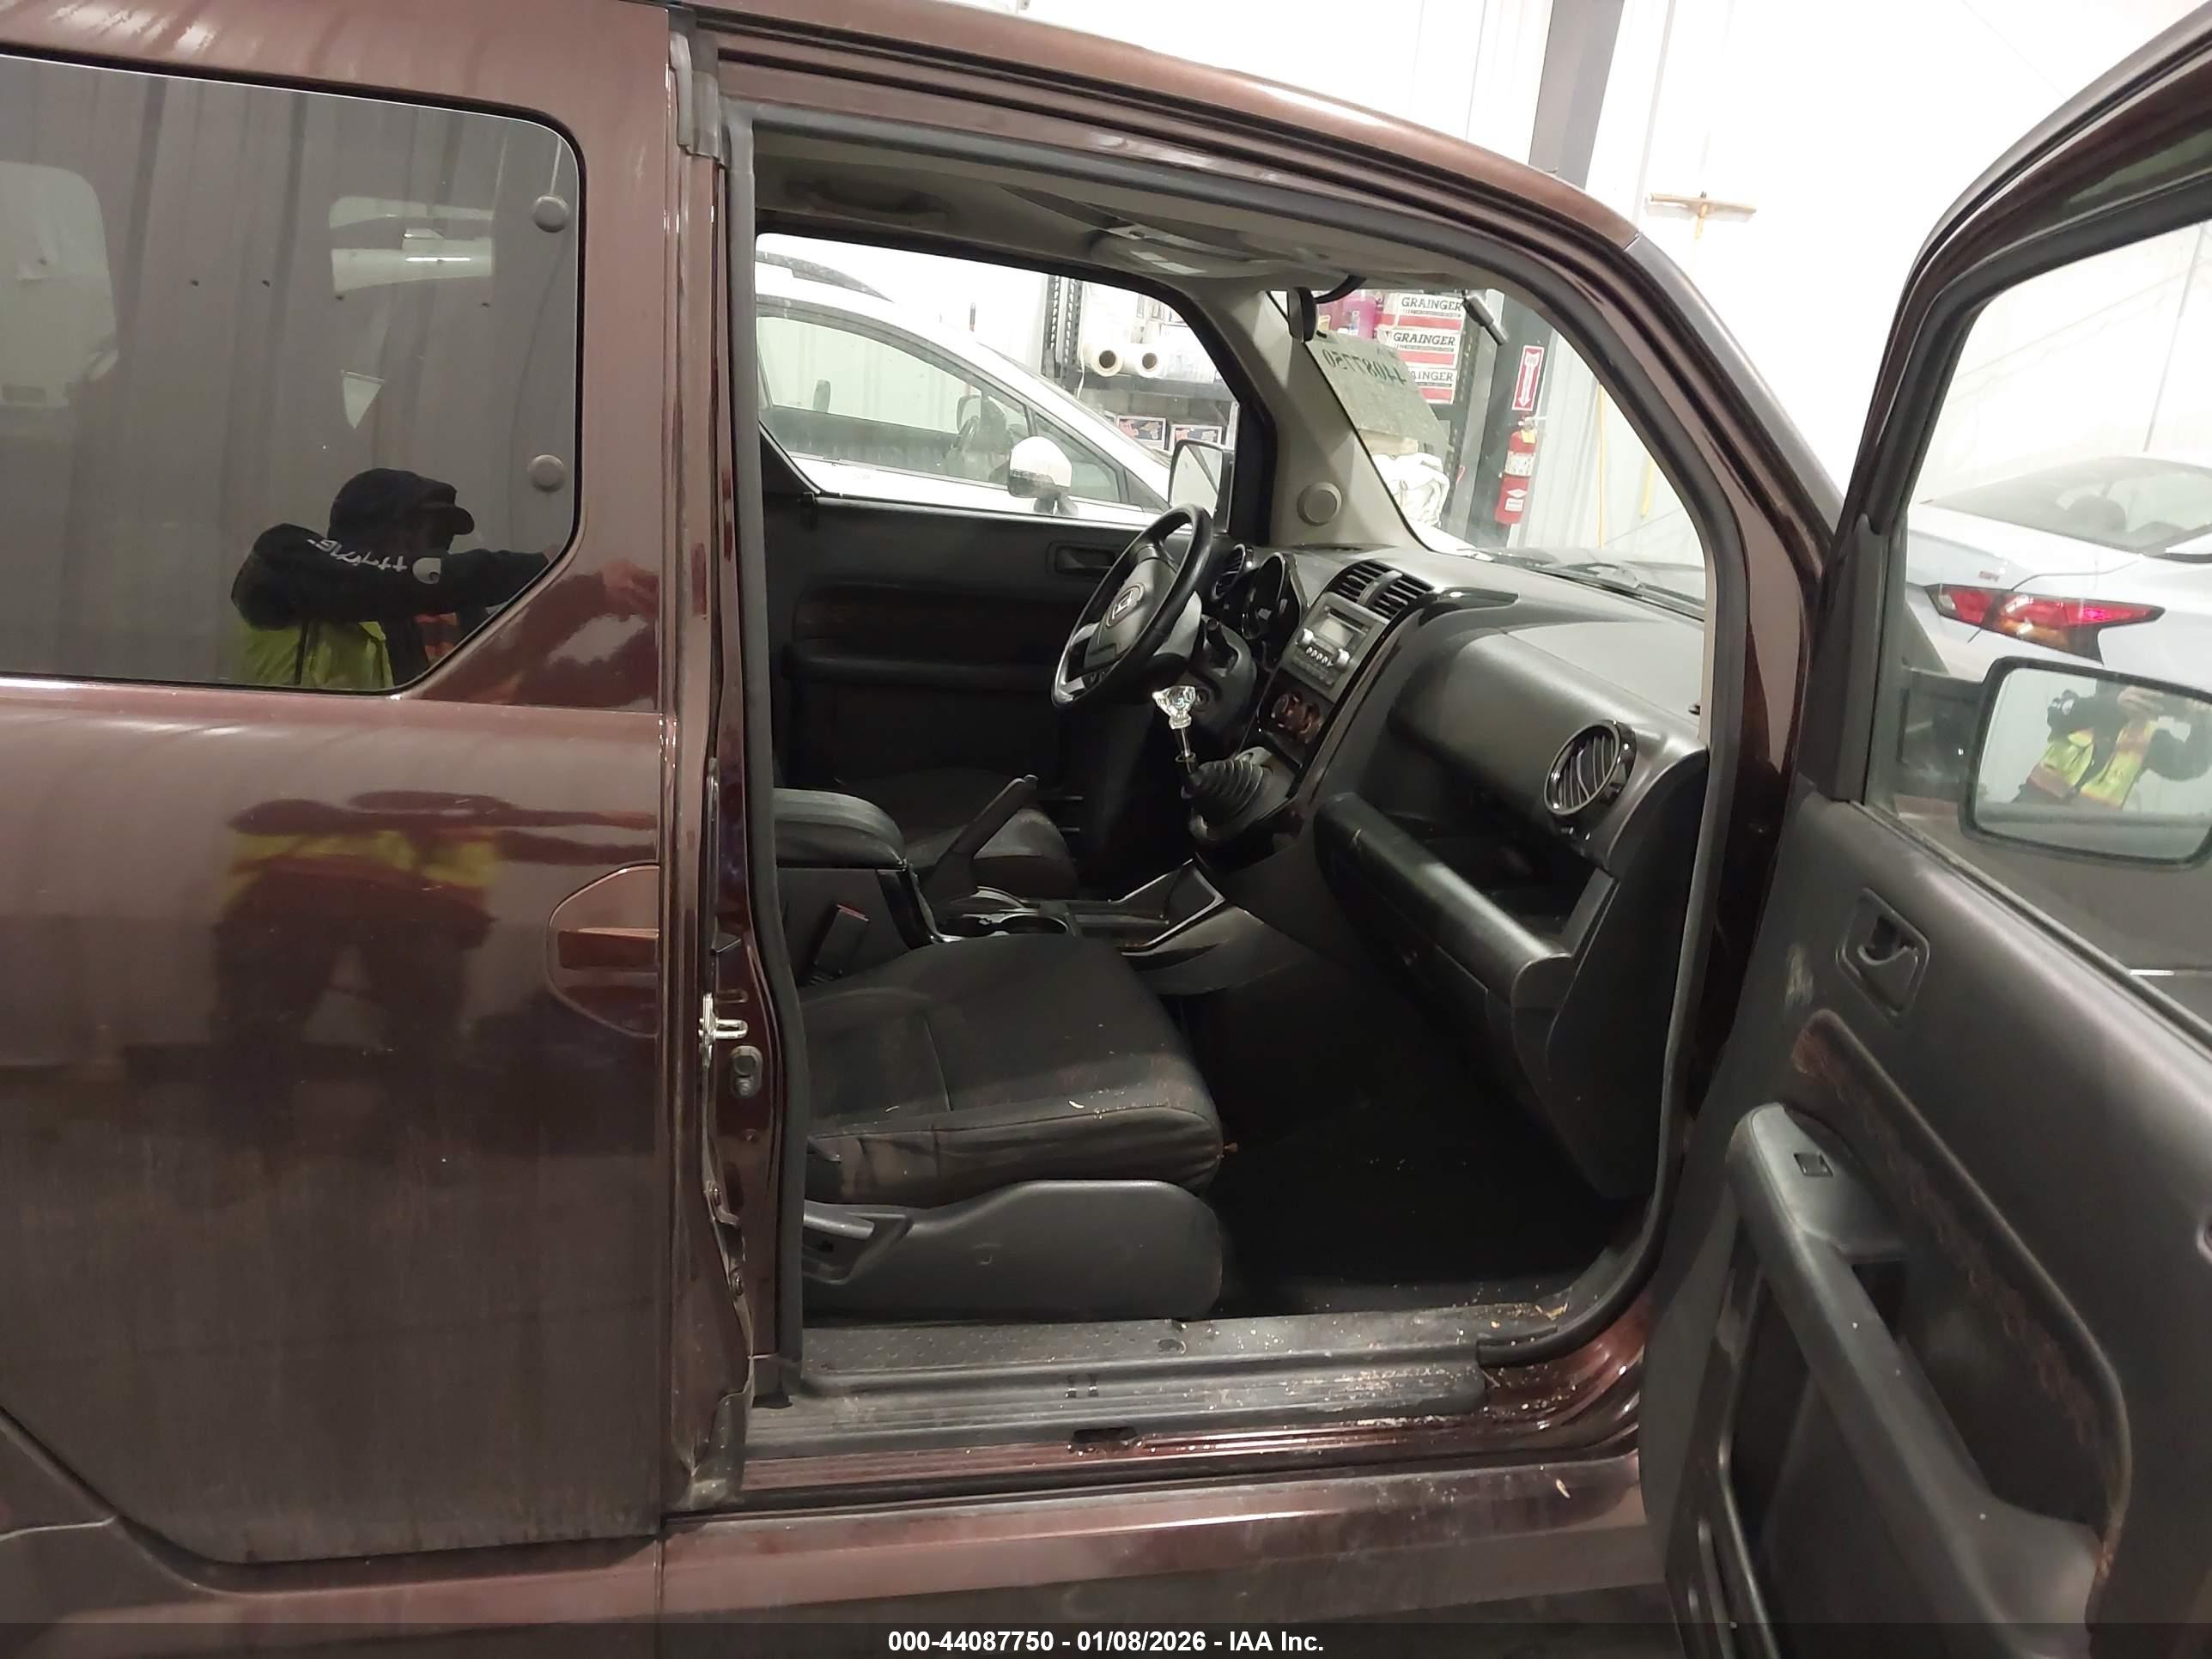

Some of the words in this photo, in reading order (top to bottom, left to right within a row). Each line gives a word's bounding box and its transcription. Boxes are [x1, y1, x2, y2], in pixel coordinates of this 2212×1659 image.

[1401, 296, 1462, 312] GRAINGER
[1393, 331, 1455, 346] GRAINGER
[1410, 370, 1454, 382] AINGER
